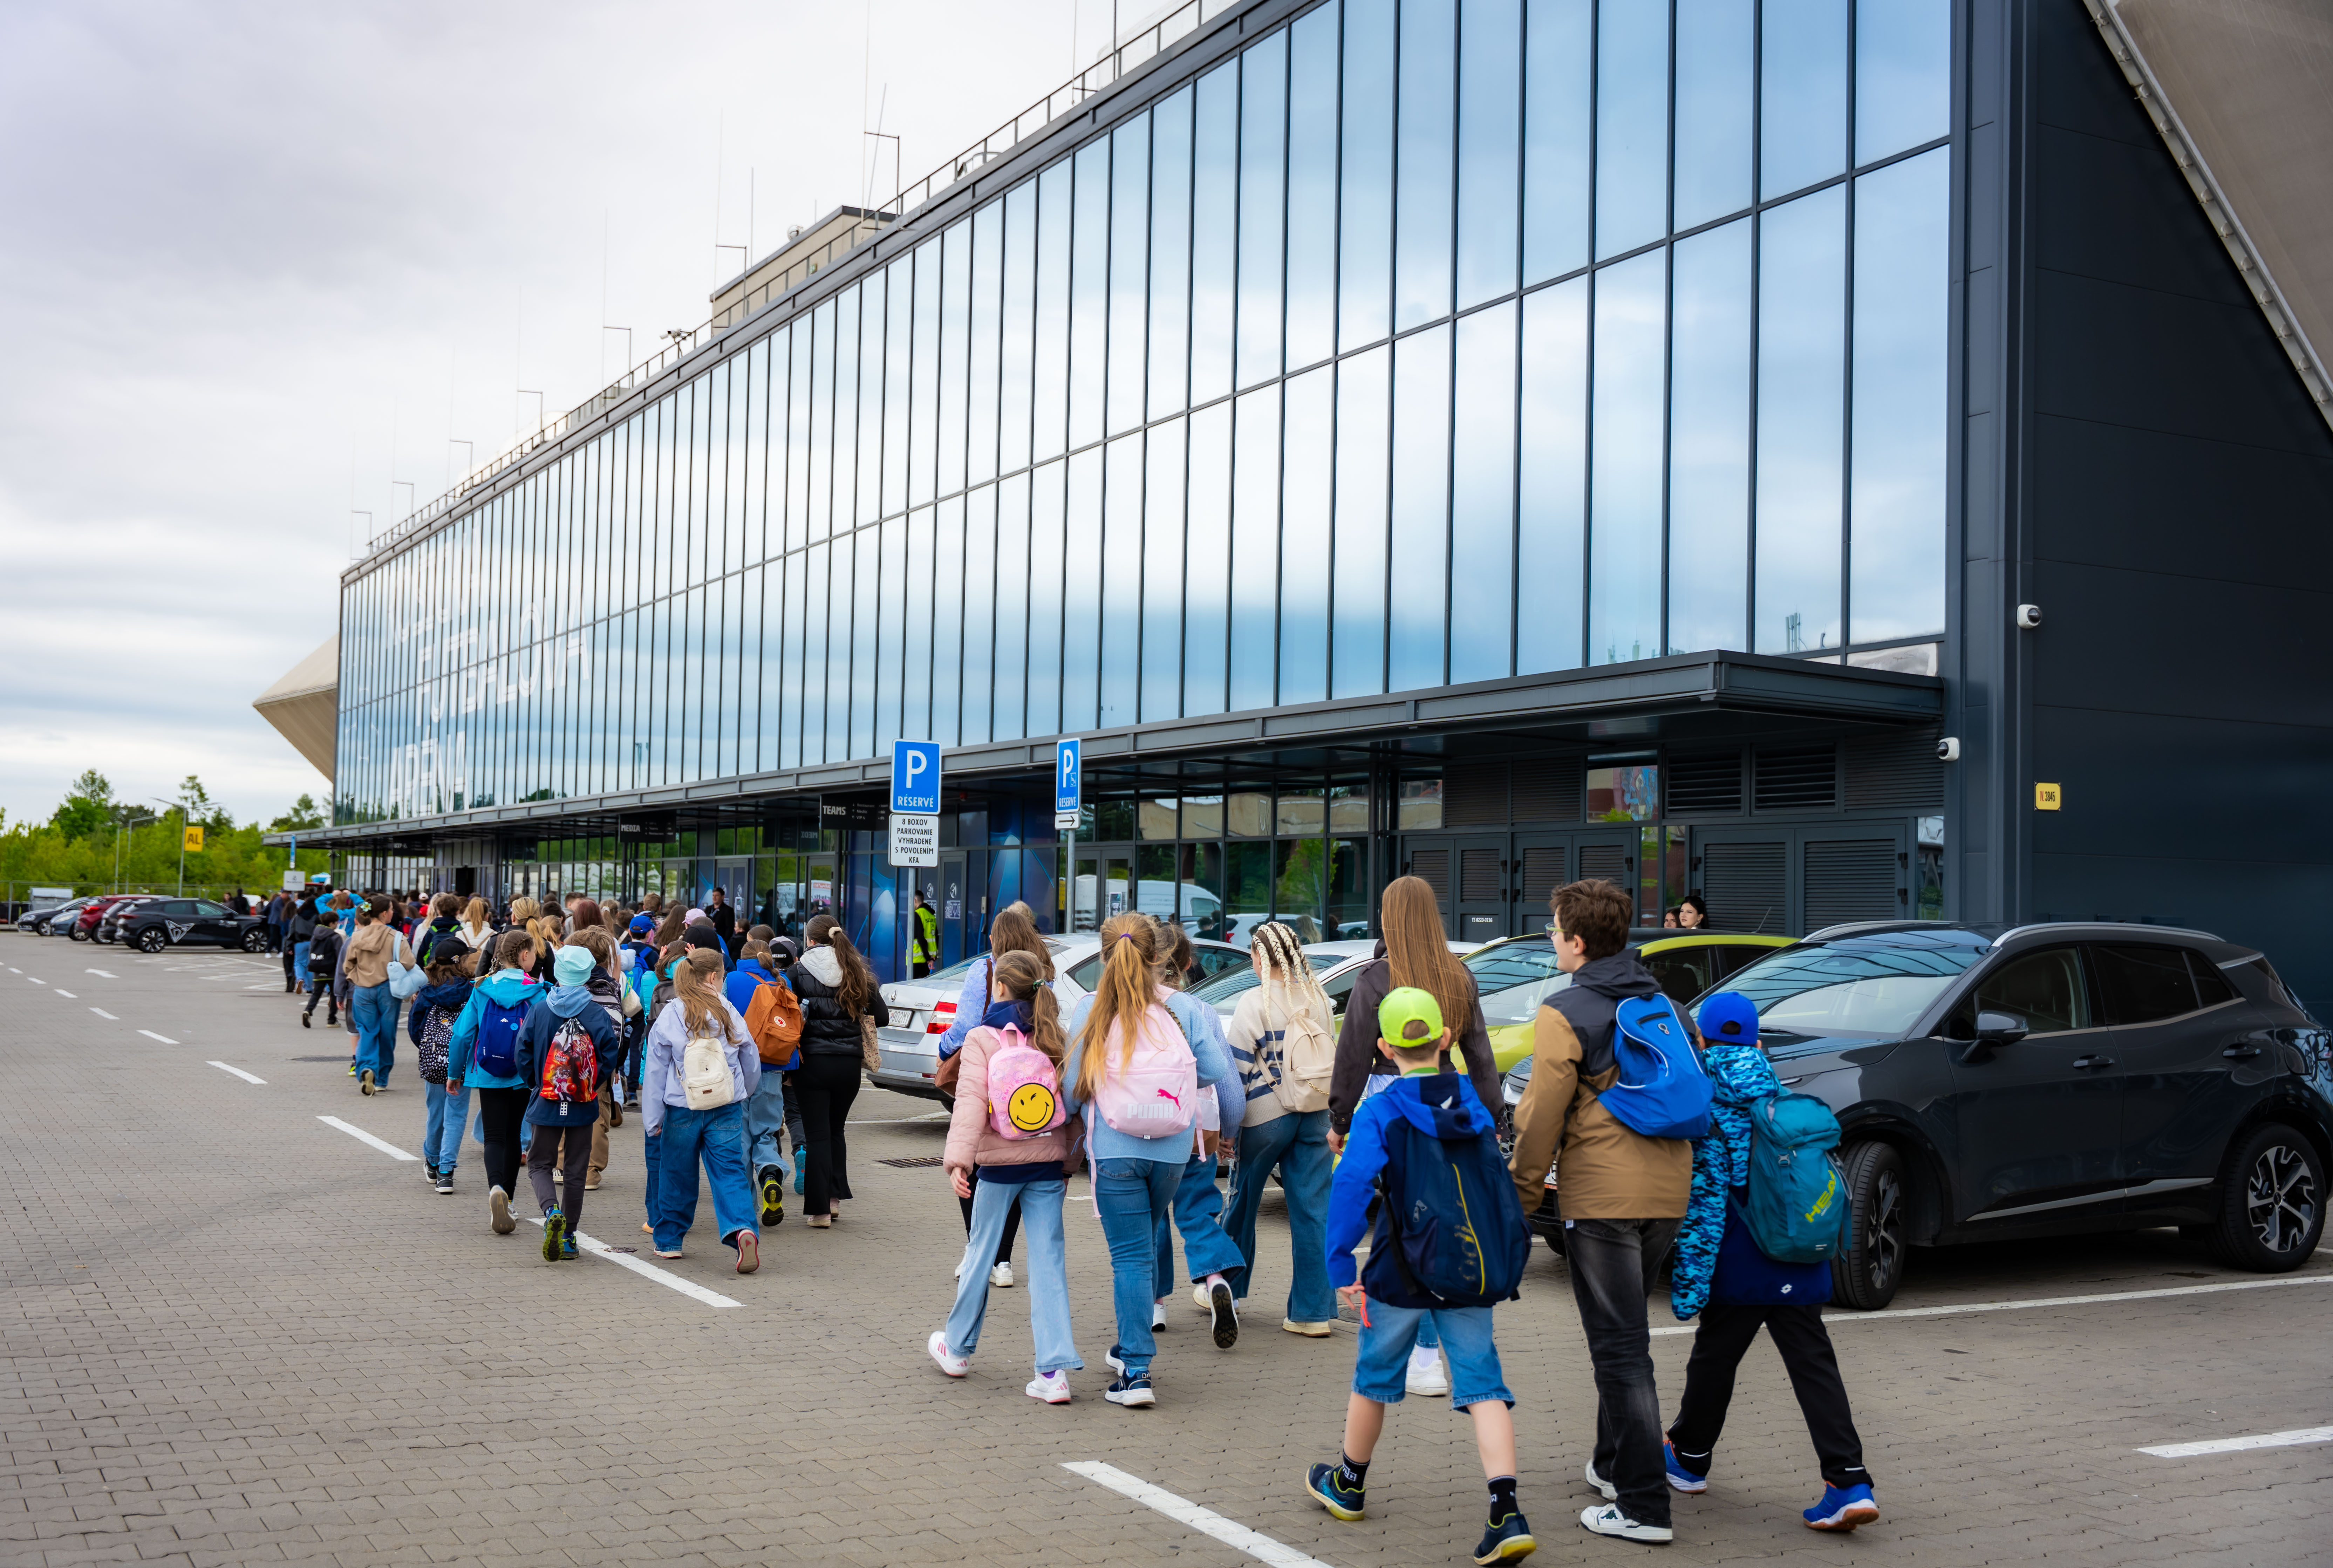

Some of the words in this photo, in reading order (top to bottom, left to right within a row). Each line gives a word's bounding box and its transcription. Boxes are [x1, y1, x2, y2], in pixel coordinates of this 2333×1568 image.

[388, 725, 469, 820] ARÉNA
[906, 750, 927, 788] P
[1063, 749, 1073, 788] P
[898, 793, 934, 807] RÉSERVÉ
[1059, 794, 1076, 807] RÉSERVÉ
[2045, 791, 2055, 802] 3845
[823, 805, 846, 815] TEAMS
[621, 824, 640, 832] MEDIA
[187, 833, 201, 844] AL
[898, 837, 932, 845] VYHRADENÉ
[901, 846, 934, 854] POVOLENÍM
[1127, 1103, 1174, 1119] PUMA
